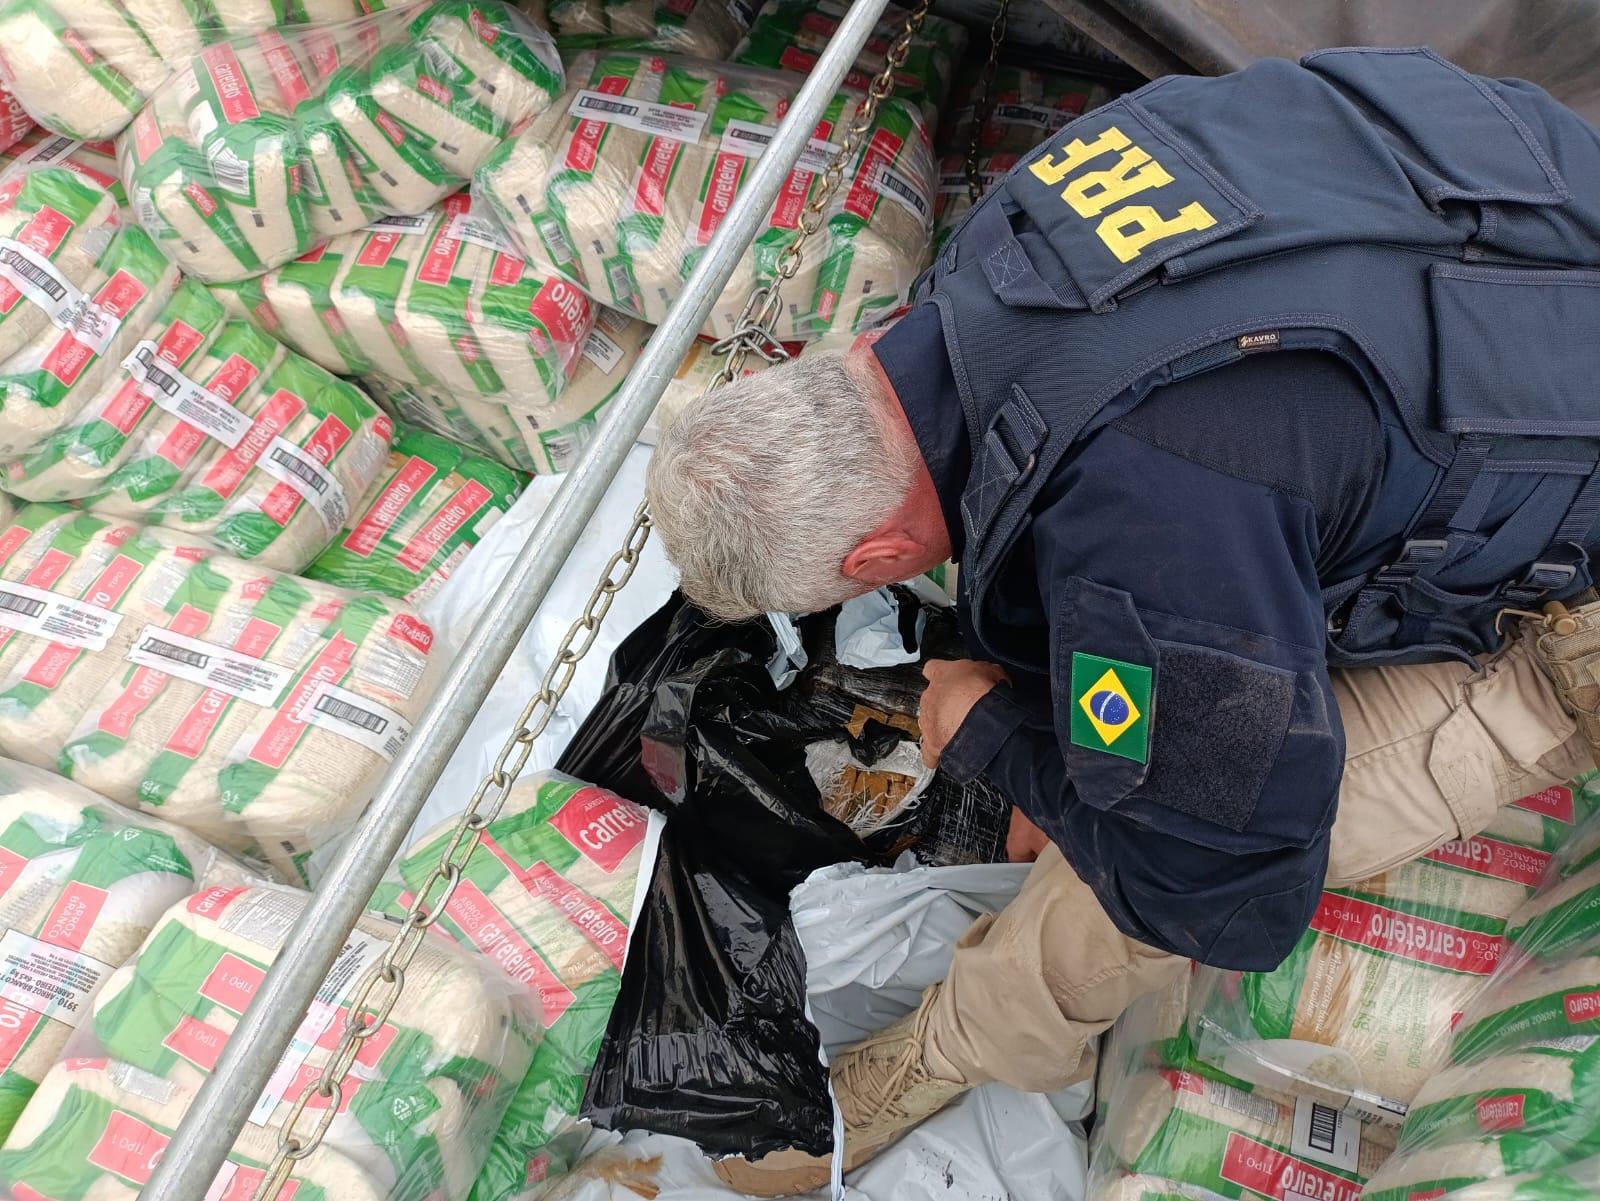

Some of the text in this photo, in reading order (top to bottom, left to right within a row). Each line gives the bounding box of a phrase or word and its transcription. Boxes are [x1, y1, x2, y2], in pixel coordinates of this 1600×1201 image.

[711, 158, 739, 214] carreteiro
[1028, 126, 1218, 263] PRF
[1247, 332, 1275, 343] KAVRO
[234, 415, 279, 464] carreteiro
[373, 480, 411, 527] carreteiro
[424, 504, 467, 545] carreteiro
[135, 667, 164, 701] carre
[1494, 846, 1547, 868] BRANCO
[1501, 856, 1543, 875] ARROZ
[46, 891, 80, 942] BRANCO
[58, 898, 87, 941] ARROZ
[462, 896, 484, 921] ARROZ
[560, 893, 618, 945] carreteiro
[1332, 907, 1362, 924] TIPO
[1370, 914, 1466, 960] carreteiro
[477, 922, 536, 983] carreteiro
[3, 974, 32, 992] BRANCO
[30, 985, 55, 1000] ARROZ
[34, 978, 76, 998] CARRETEIRO
[225, 973, 254, 994] TIPO
[56, 996, 79, 1012] 3910
[192, 1028, 219, 1049] TIPO
[1478, 1099, 1520, 1121] carreteiro
[117, 1134, 146, 1157] TIPO
[1244, 1157, 1274, 1175] TIPO
